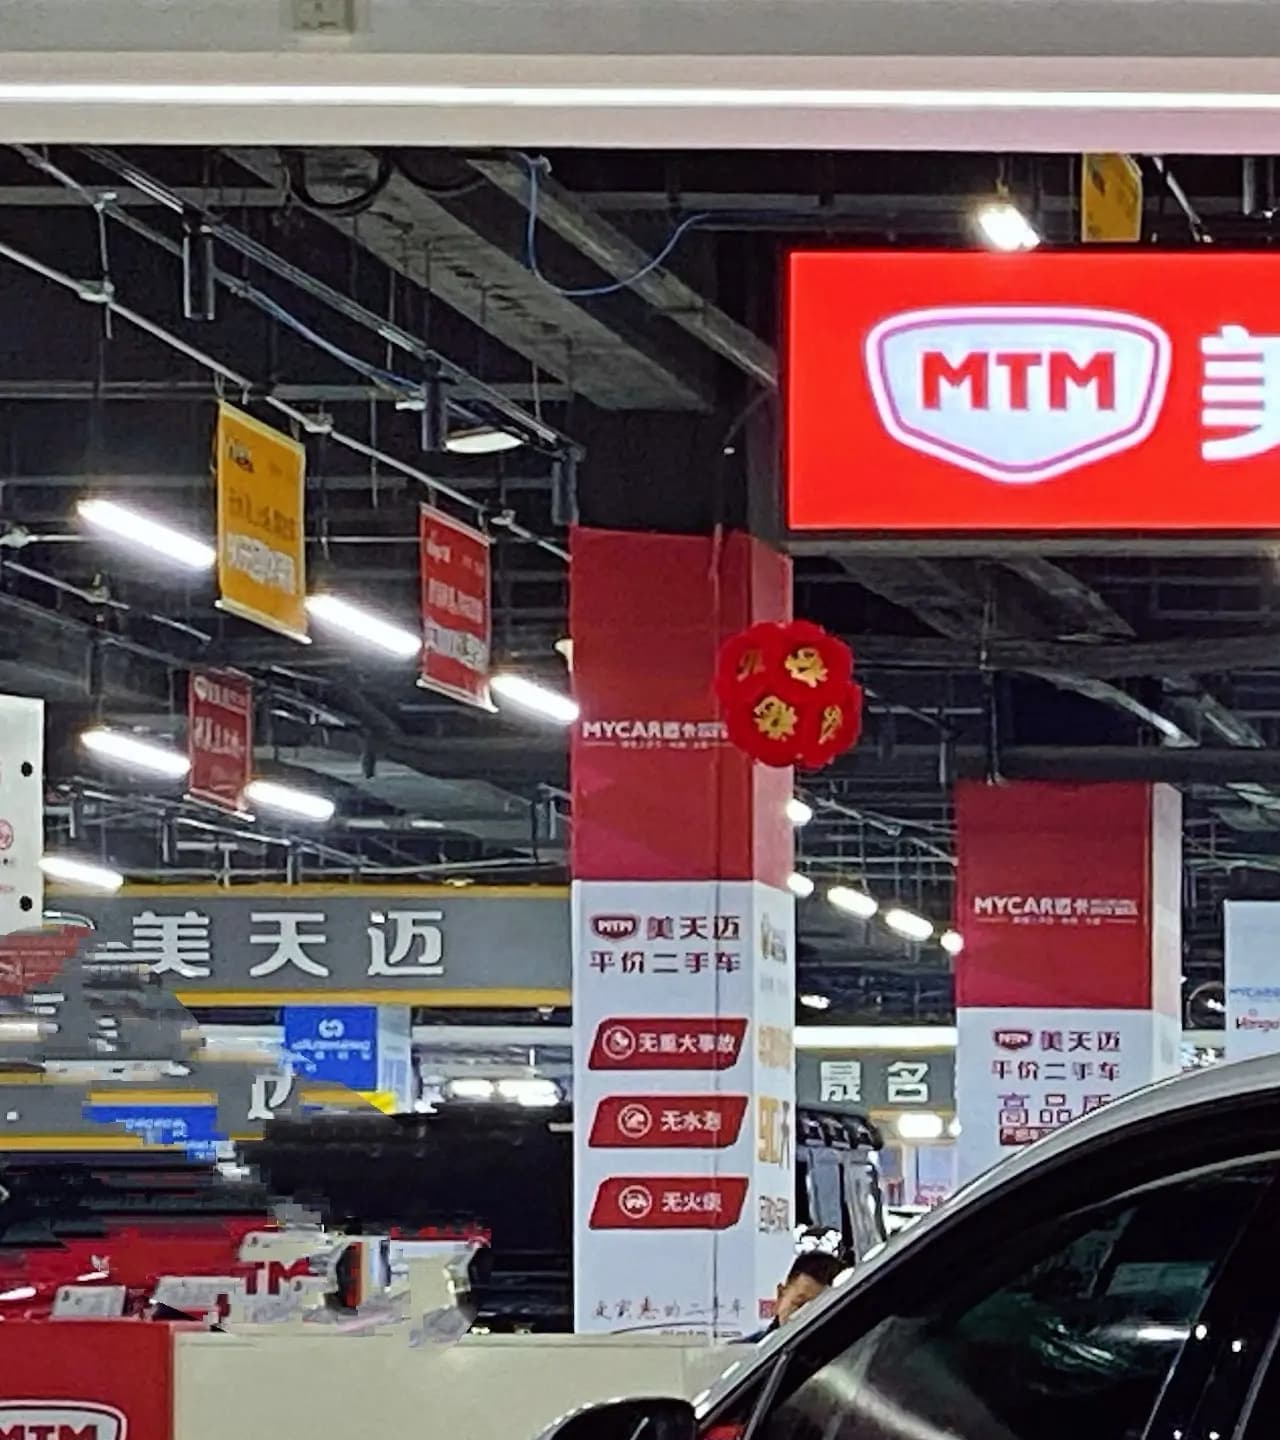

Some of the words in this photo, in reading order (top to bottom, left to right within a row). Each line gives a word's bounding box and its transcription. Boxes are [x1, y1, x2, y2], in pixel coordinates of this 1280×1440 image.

[922, 351, 1116, 411] MTM
[647, 915, 741, 940] 美天迈
[132, 911, 444, 977] 美天迈
[590, 950, 741, 974] 平价二手车
[638, 1033, 736, 1054] 无重大事故
[1041, 1030, 1121, 1052] 美天迈
[992, 1060, 1121, 1082] 平价二手车
